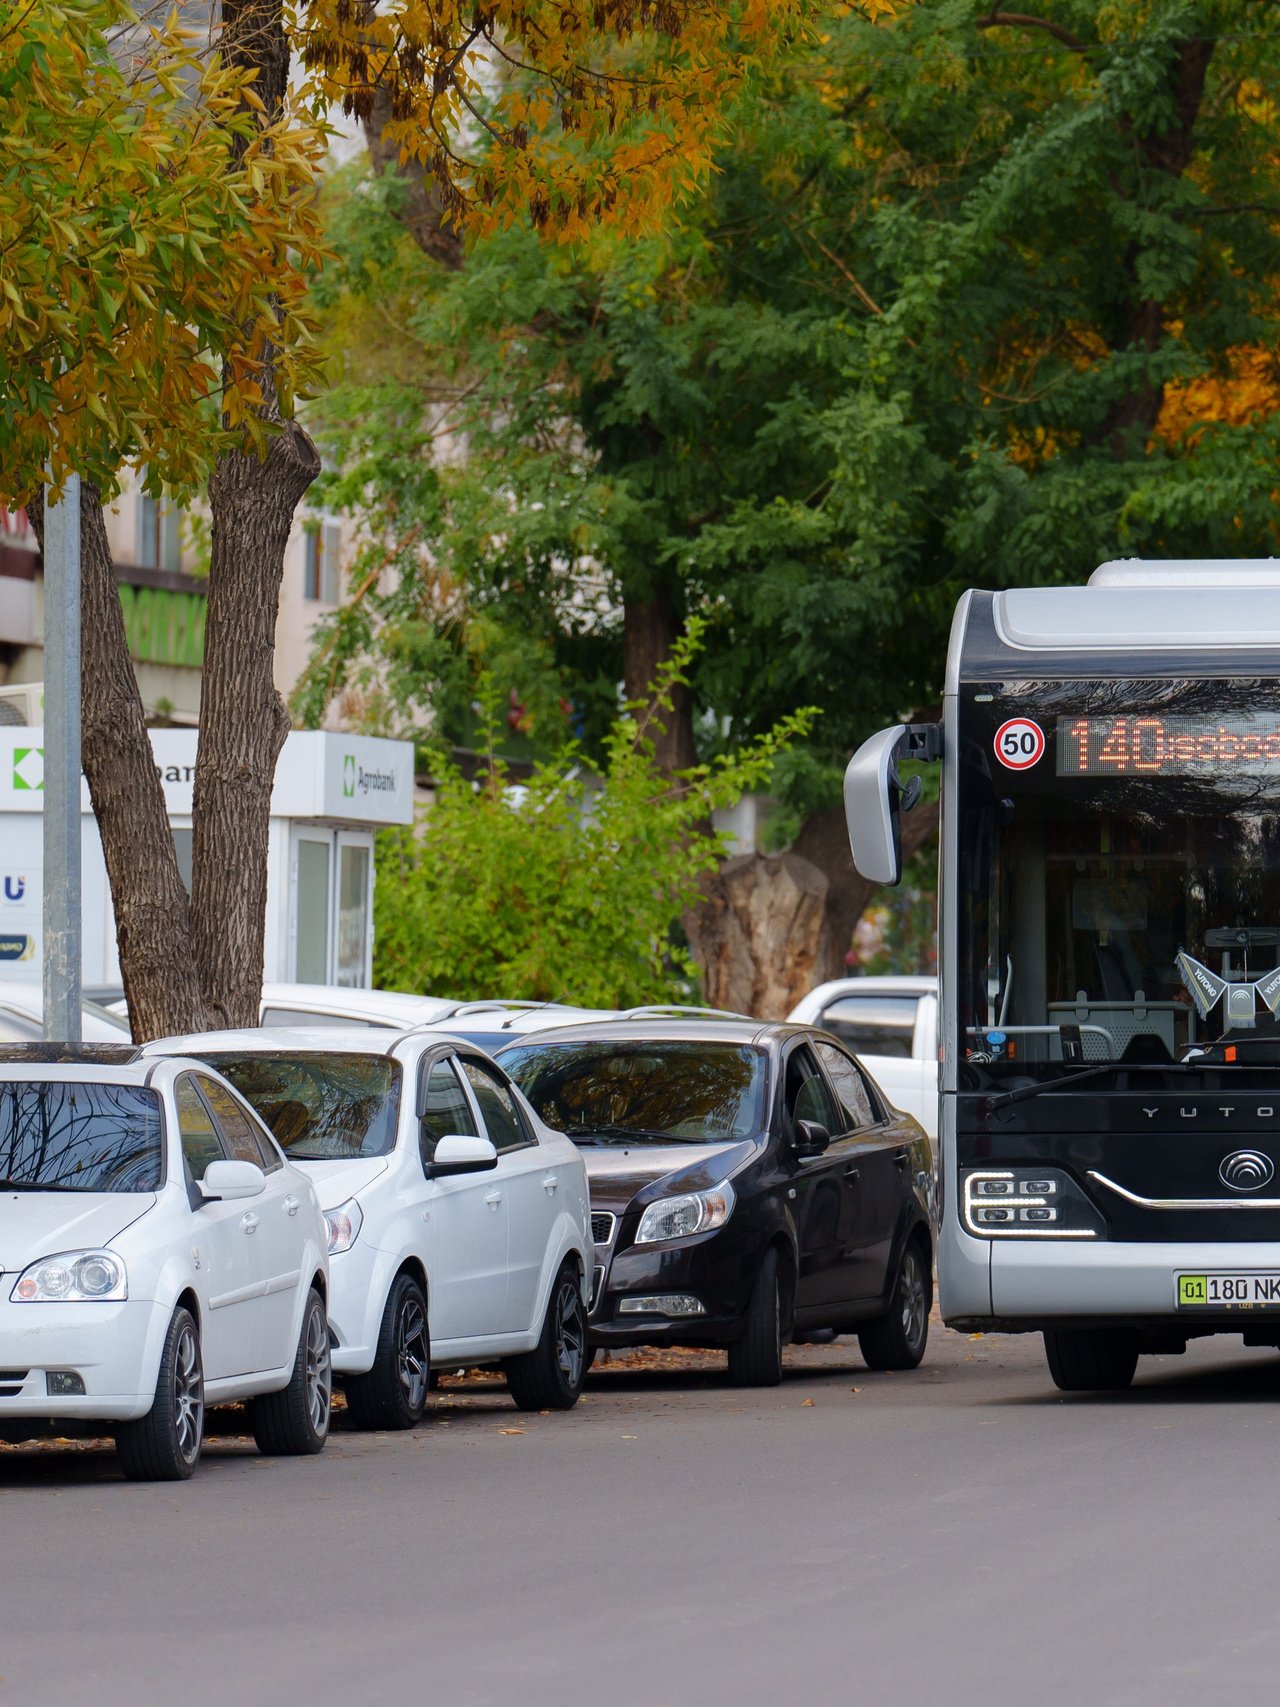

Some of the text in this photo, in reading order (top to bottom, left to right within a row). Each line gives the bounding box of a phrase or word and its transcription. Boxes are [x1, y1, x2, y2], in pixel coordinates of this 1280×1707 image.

[1004, 732, 1035, 756] 50
[1072, 719, 1163, 769] 140
[358, 766, 396, 795] Agrobank
[1194, 968, 1217, 997] YUTONG
[1185, 1282, 1204, 1298] 01
[1209, 1279, 1248, 1300] 180
